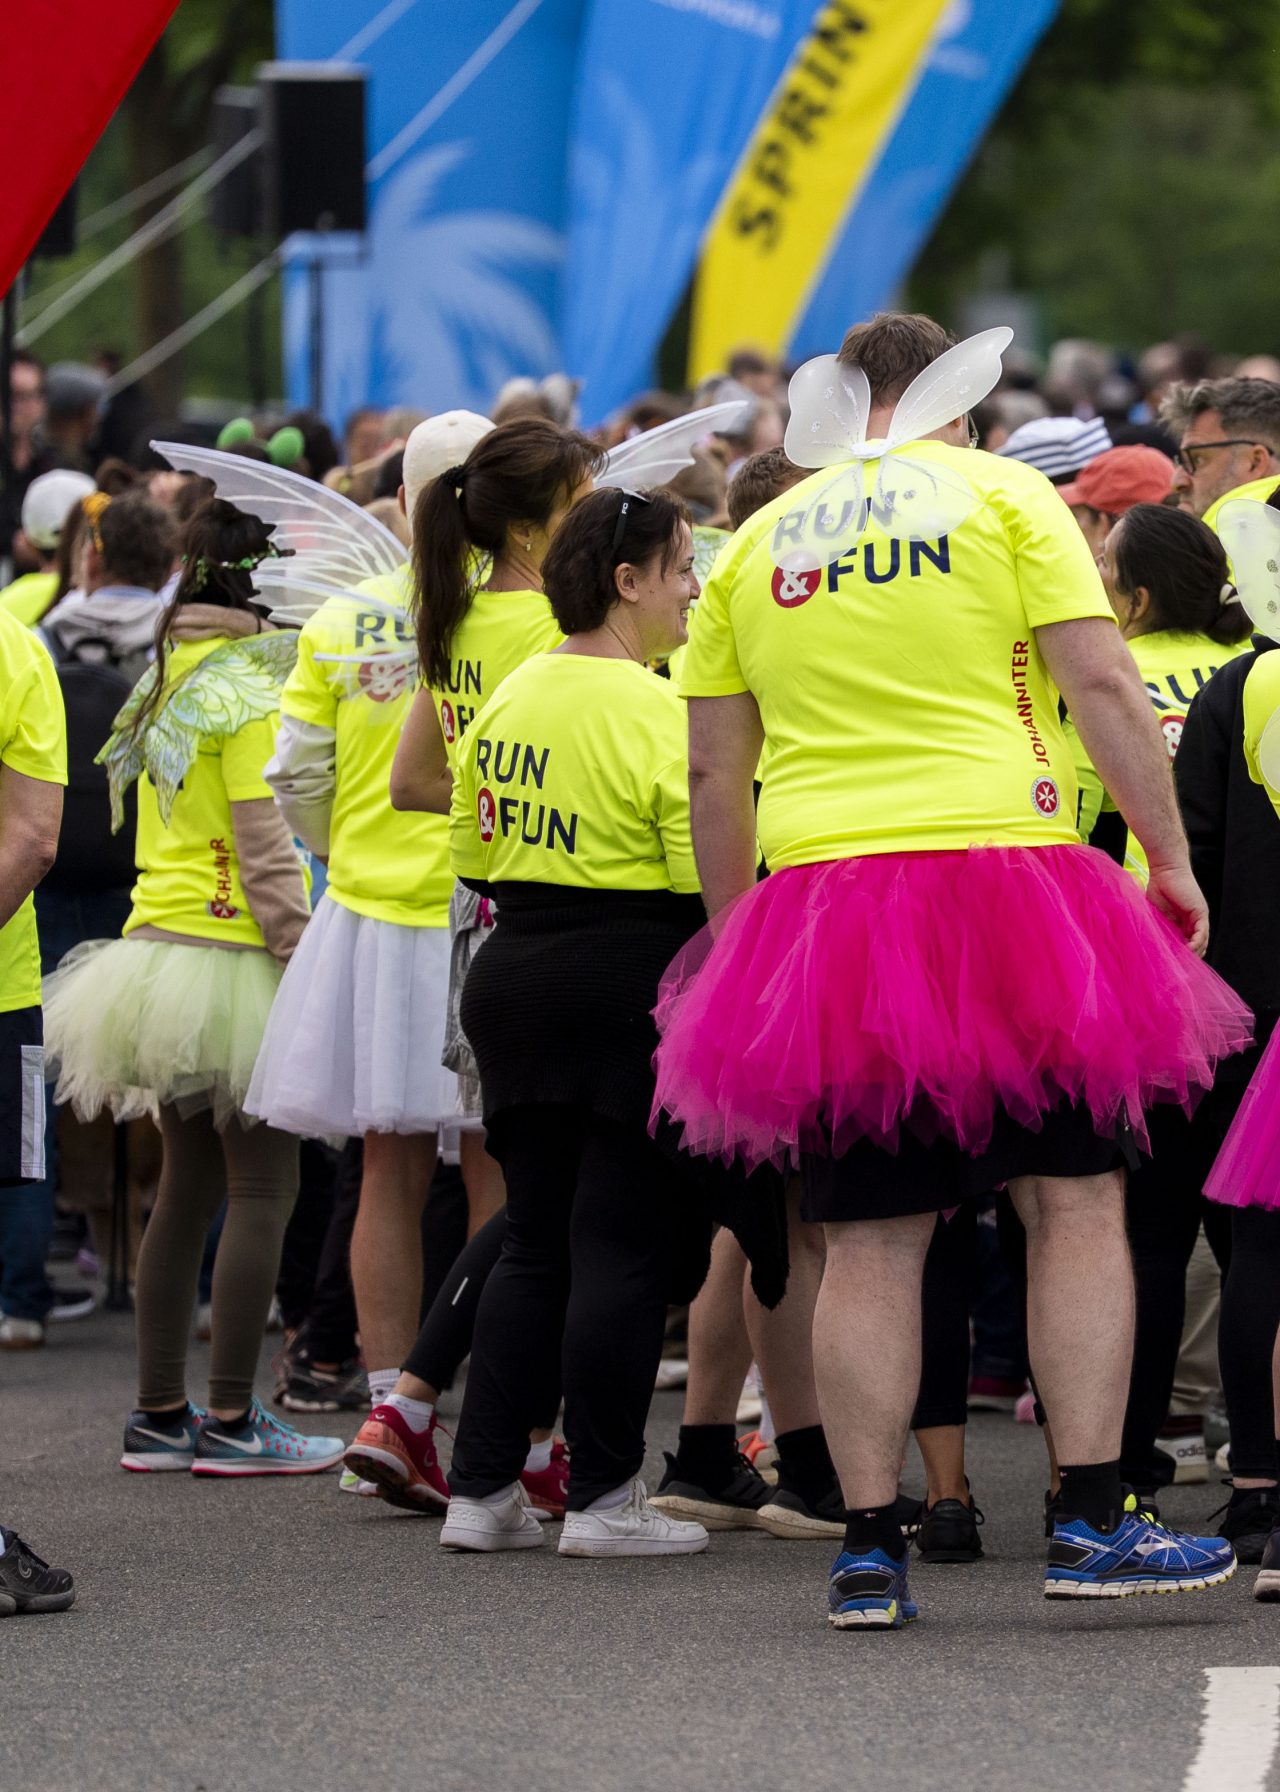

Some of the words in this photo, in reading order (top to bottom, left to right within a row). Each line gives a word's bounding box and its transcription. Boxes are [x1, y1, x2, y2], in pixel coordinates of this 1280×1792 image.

[773, 490, 896, 552] RUN
[828, 531, 951, 593] FUN
[355, 607, 418, 648] RU
[440, 659, 482, 695] UN
[1012, 640, 1050, 767] JOHANNITER
[477, 739, 550, 790] RUN
[479, 795, 495, 835] &
[499, 797, 578, 854] FUN
